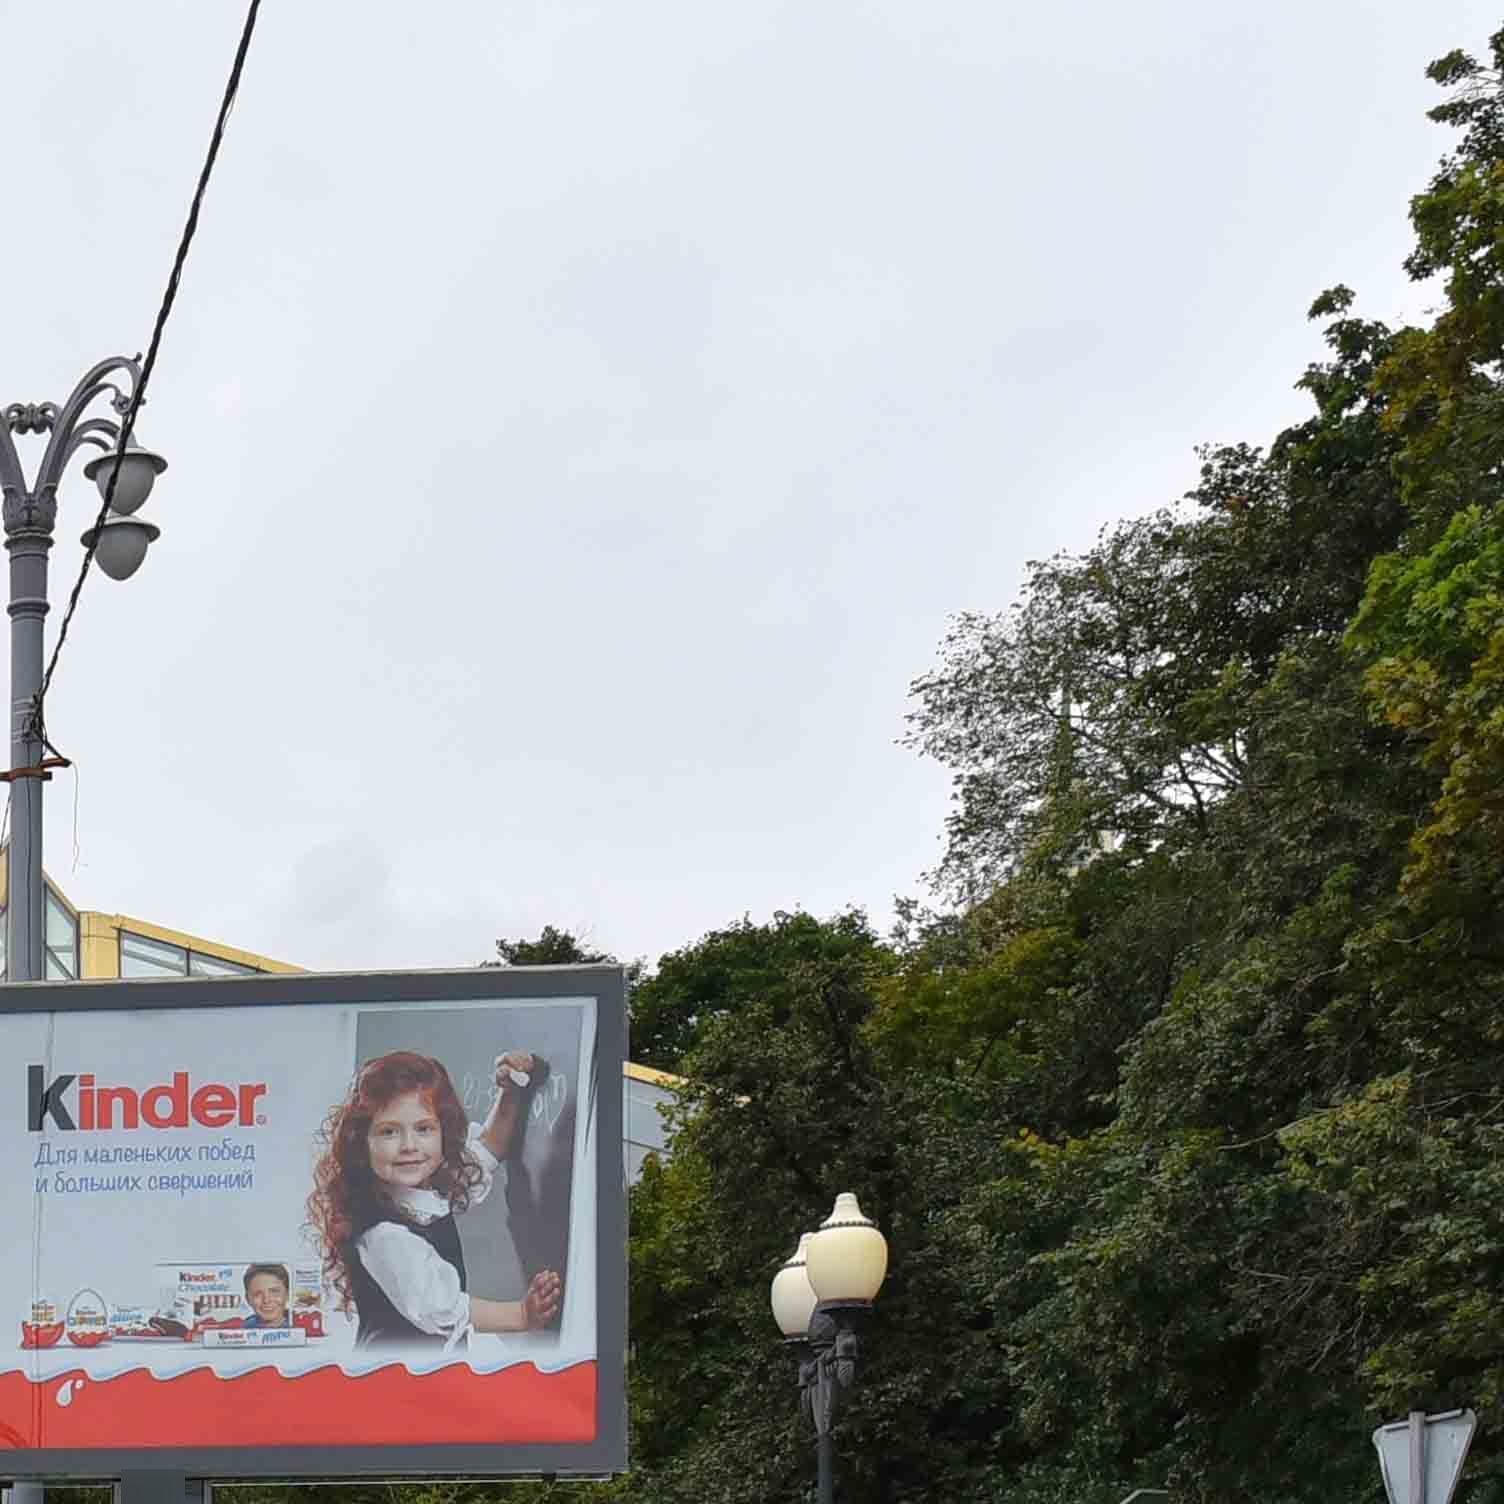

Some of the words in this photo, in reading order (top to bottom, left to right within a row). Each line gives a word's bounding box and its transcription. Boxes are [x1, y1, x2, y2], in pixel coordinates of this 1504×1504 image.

[28, 1064, 267, 1132] Kinder
[34, 1142, 78, 1168] Для
[84, 1145, 193, 1163] маленьких
[198, 1138, 256, 1162] побед
[35, 1176, 48, 1192] и
[54, 1171, 142, 1193] больших
[148, 1169, 254, 1196] свершений
